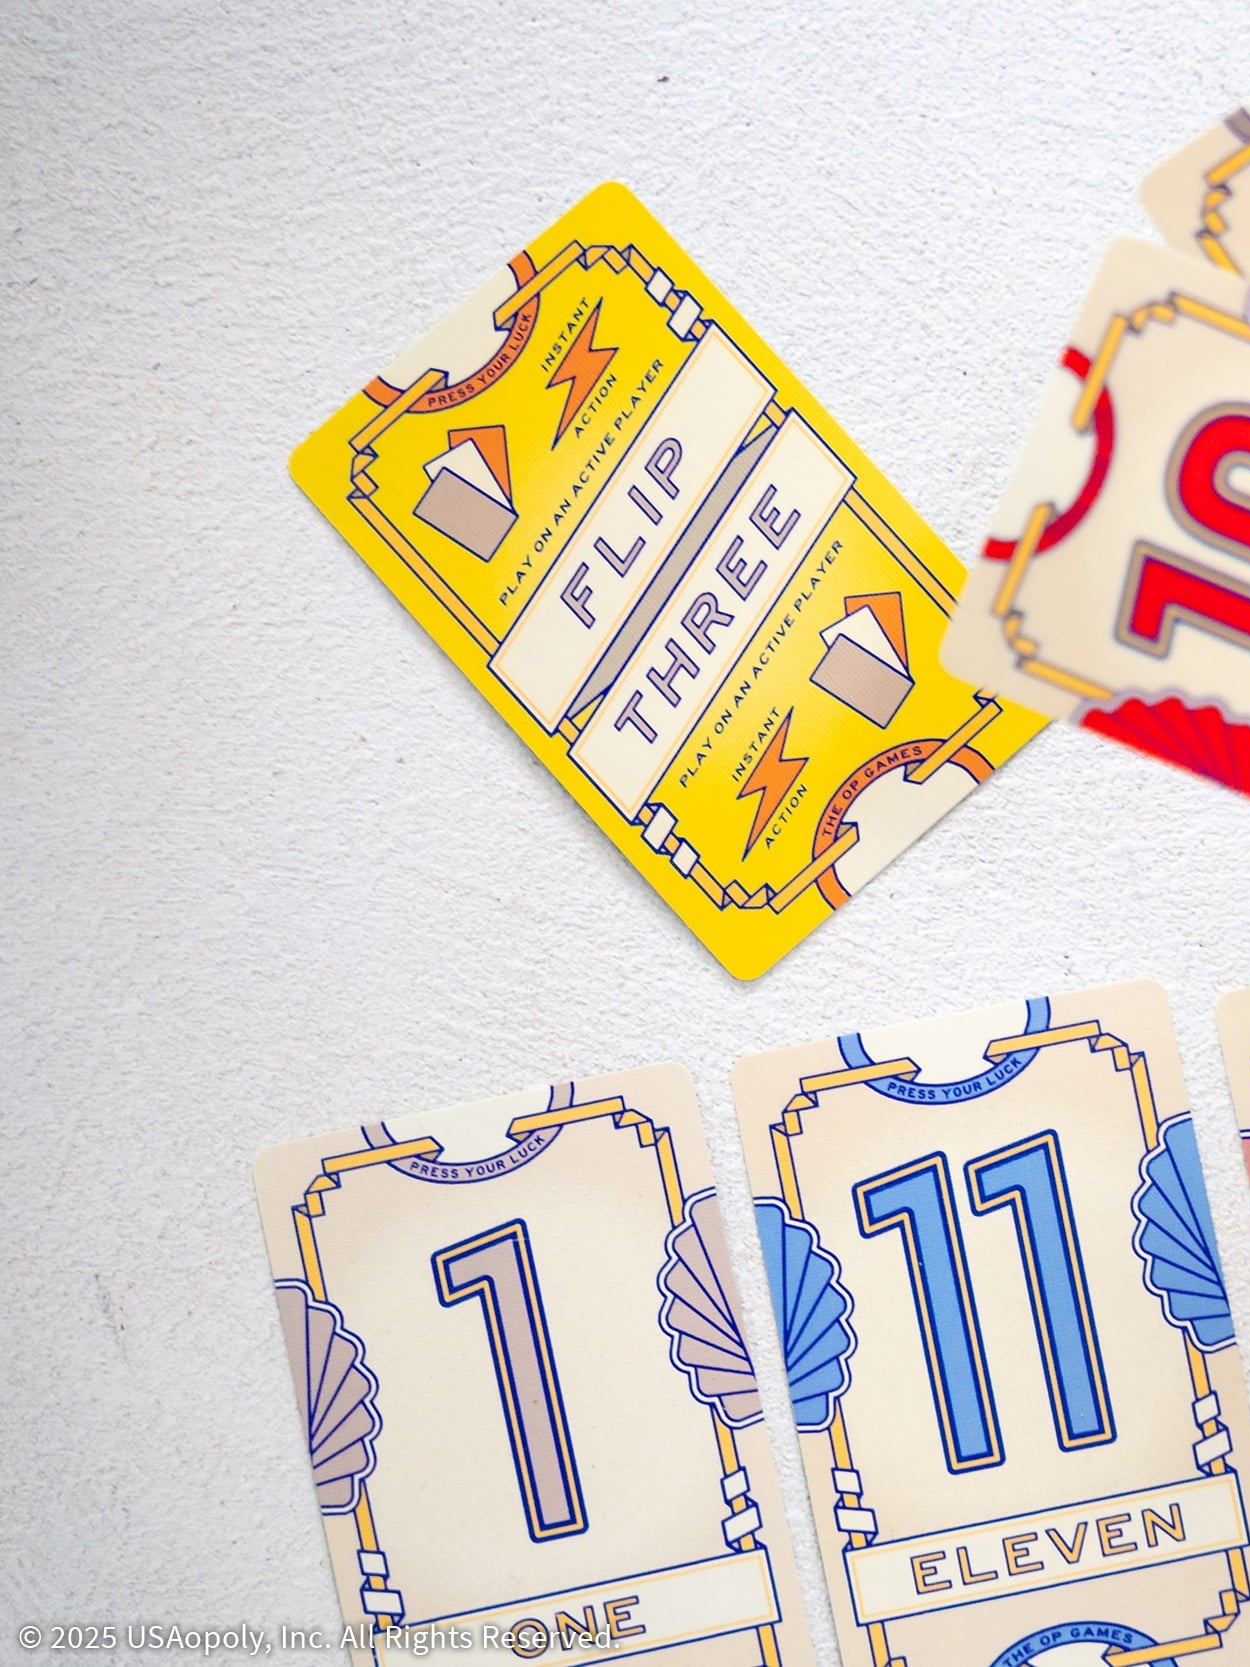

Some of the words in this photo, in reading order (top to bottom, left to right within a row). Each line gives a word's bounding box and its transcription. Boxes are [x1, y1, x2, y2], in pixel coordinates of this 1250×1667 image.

[427, 385, 475, 407] PRESS
[480, 354, 511, 386] YOUR
[508, 313, 532, 353] LUCK
[541, 297, 589, 372] INSTANT
[574, 374, 618, 439] ACTION
[499, 554, 533, 606] PLAY
[534, 527, 553, 554] ON
[553, 498, 571, 526] AN
[571, 432, 616, 498] ACTIVE
[614, 359, 664, 430] PLAYER
[560, 437, 683, 630] FLIP
[614, 484, 802, 744] THREE
[679, 737, 713, 788] PLAY
[714, 709, 733, 735] ON
[733, 681, 752, 709] AN
[752, 613, 795, 680] ACTIVE
[794, 539, 844, 612] PLAYER
[731, 707, 780, 782] INSTANT
[764, 784, 808, 849] ACTION
[823, 805, 843, 837] THE
[842, 780, 860, 800] OP
[864, 745, 923, 778] GAMES
[887, 1081, 936, 1100] PRESS
[942, 1081, 983, 1099] YOUR
[985, 1057, 1022, 1086] LUCK
[410, 1161, 459, 1179] PRESS
[465, 1160, 506, 1178] YOUR
[509, 1135, 545, 1164] LUCK
[852, 1128, 1117, 1475] 11
[431, 1217, 589, 1543] 1
[910, 1502, 1188, 1595] ELEVEN
[509, 1595, 646, 1659] ONE
[1002, 1643, 1035, 1667] THE
[1040, 1631, 1062, 1646] OP
[1070, 1627, 1133, 1644] GAMES
